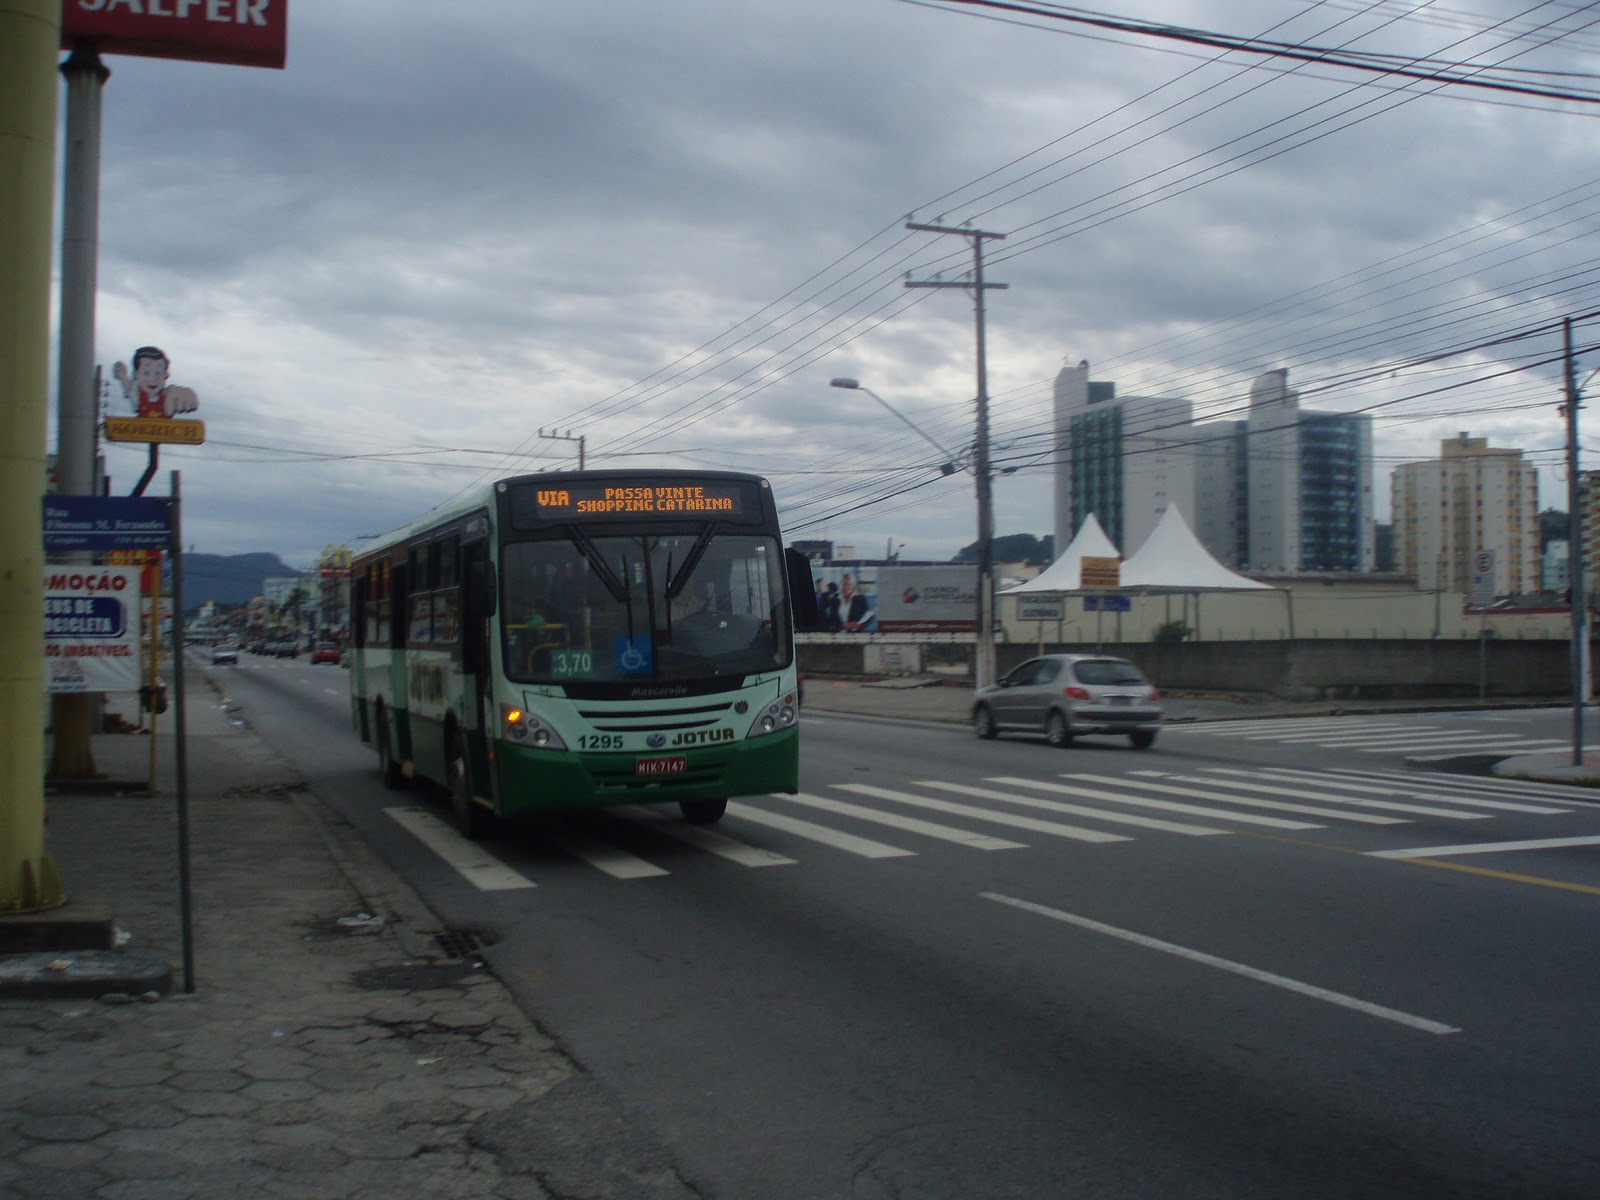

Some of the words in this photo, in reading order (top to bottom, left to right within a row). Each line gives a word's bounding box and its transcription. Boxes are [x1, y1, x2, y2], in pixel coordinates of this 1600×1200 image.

[537, 490, 570, 506] VIA
[605, 487, 653, 500] PASSA
[655, 486, 704, 499] VINTE
[576, 499, 654, 513] SHOPPING
[656, 498, 733, 511] CATARINA
[74, 599, 95, 614] DE
[578, 735, 624, 750] 1295
[672, 728, 735, 746] JOTUR
